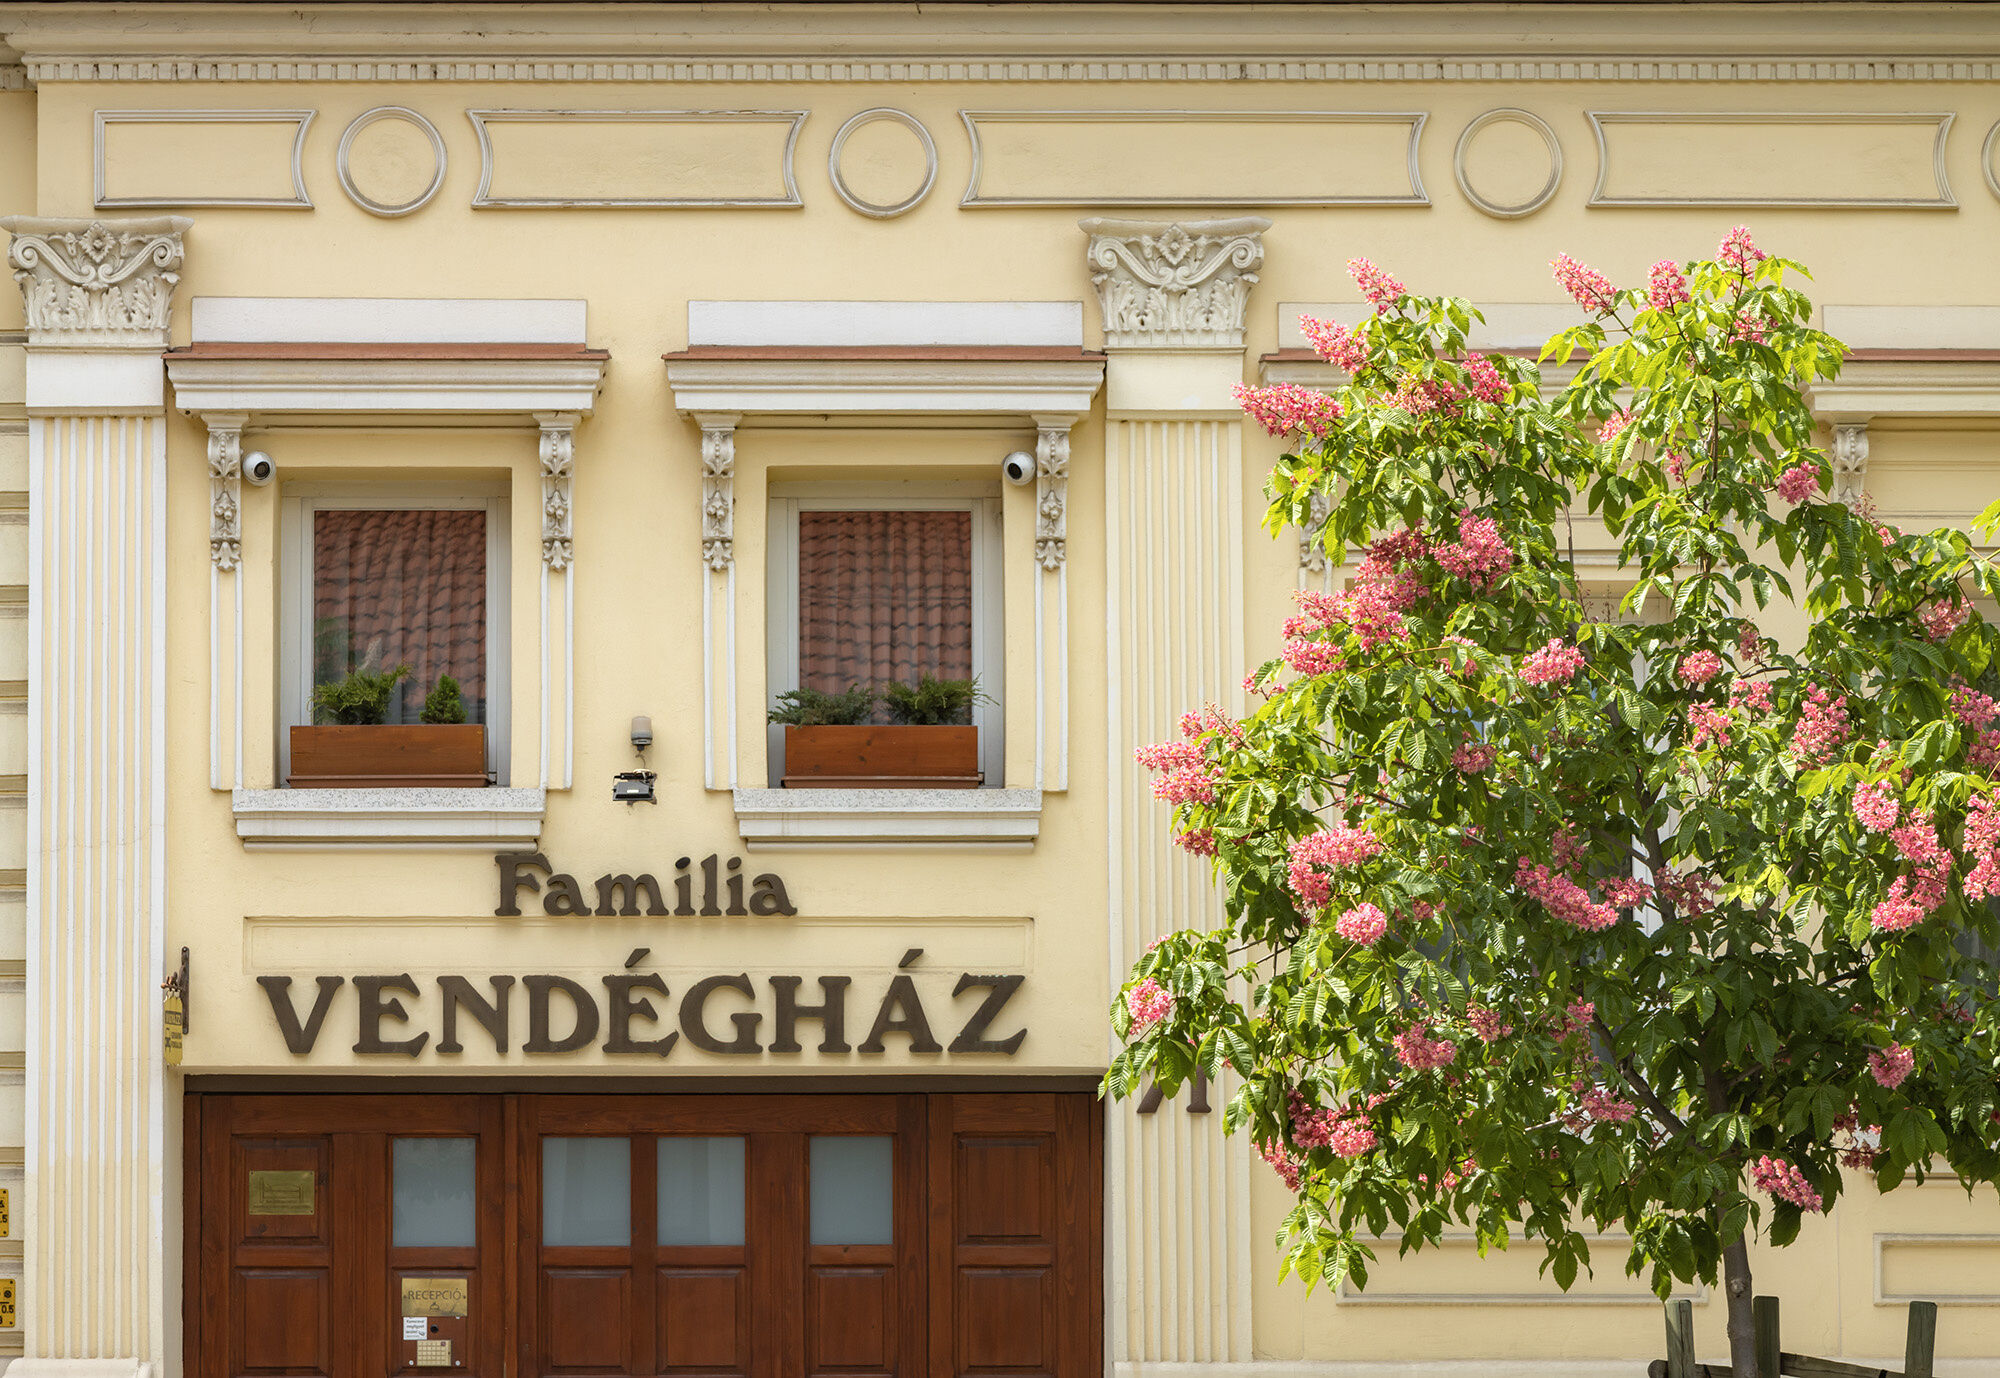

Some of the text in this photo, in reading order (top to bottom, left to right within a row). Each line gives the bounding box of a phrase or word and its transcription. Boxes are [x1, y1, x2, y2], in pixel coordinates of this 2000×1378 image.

[494, 853, 797, 917] Familia
[256, 948, 1028, 1058] VENDÉGHÁZ
[1, 1304, 15, 1314] 0.5
[407, 1288, 462, 1301] RECEPCIÓ
